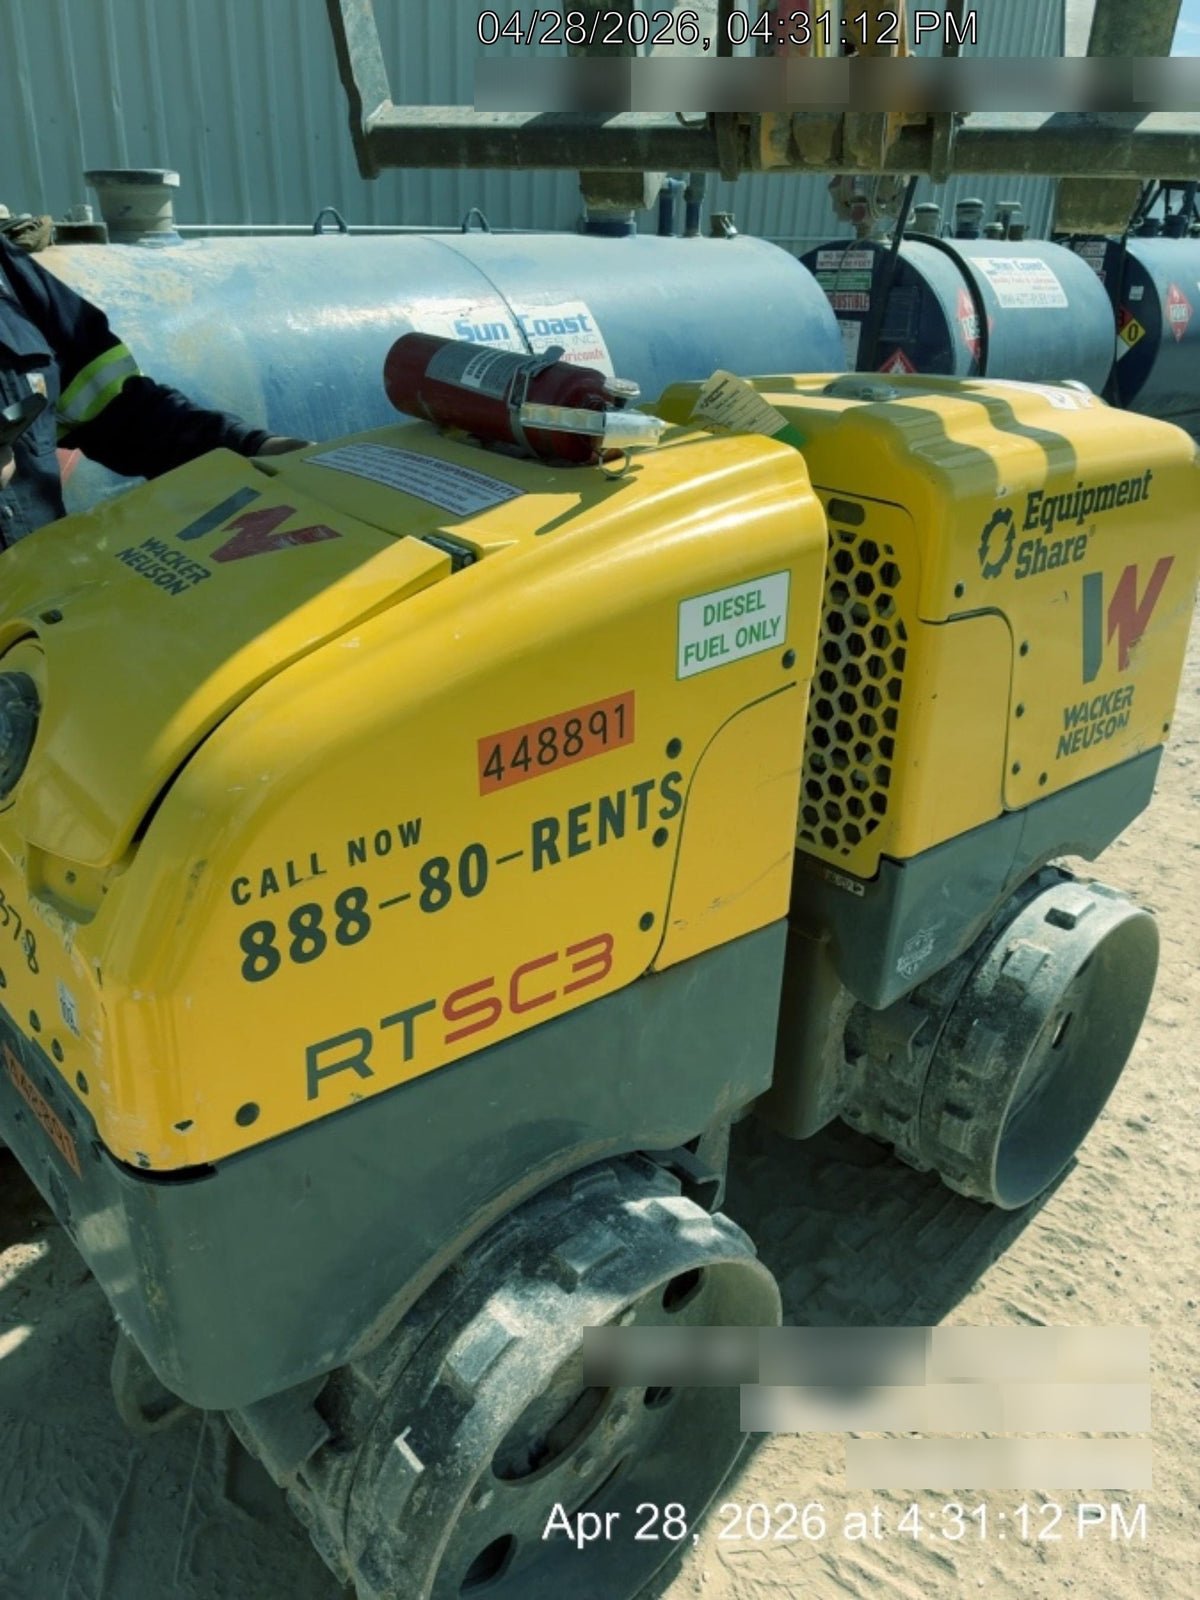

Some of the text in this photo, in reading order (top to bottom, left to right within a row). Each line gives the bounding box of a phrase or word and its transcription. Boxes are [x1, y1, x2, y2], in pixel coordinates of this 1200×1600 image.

[454, 313, 592, 342] Sun Coast
[1128, 323, 1139, 342] 0
[1022, 469, 1153, 534] Equipment
[114, 547, 190, 596] NEUSON
[139, 537, 212, 584] WACKER
[1014, 534, 1088, 580] Share
[703, 589, 766, 627] DIESEL
[683, 614, 781, 667] FUEL ONLY
[1062, 685, 1135, 731] WACKER
[482, 703, 626, 782] 448891
[1056, 710, 1131, 760] NEUSON
[230, 817, 423, 906] CALL NOW
[238, 770, 684, 984] 888-80-RENTS
[305, 932, 615, 1102] RTSC3
